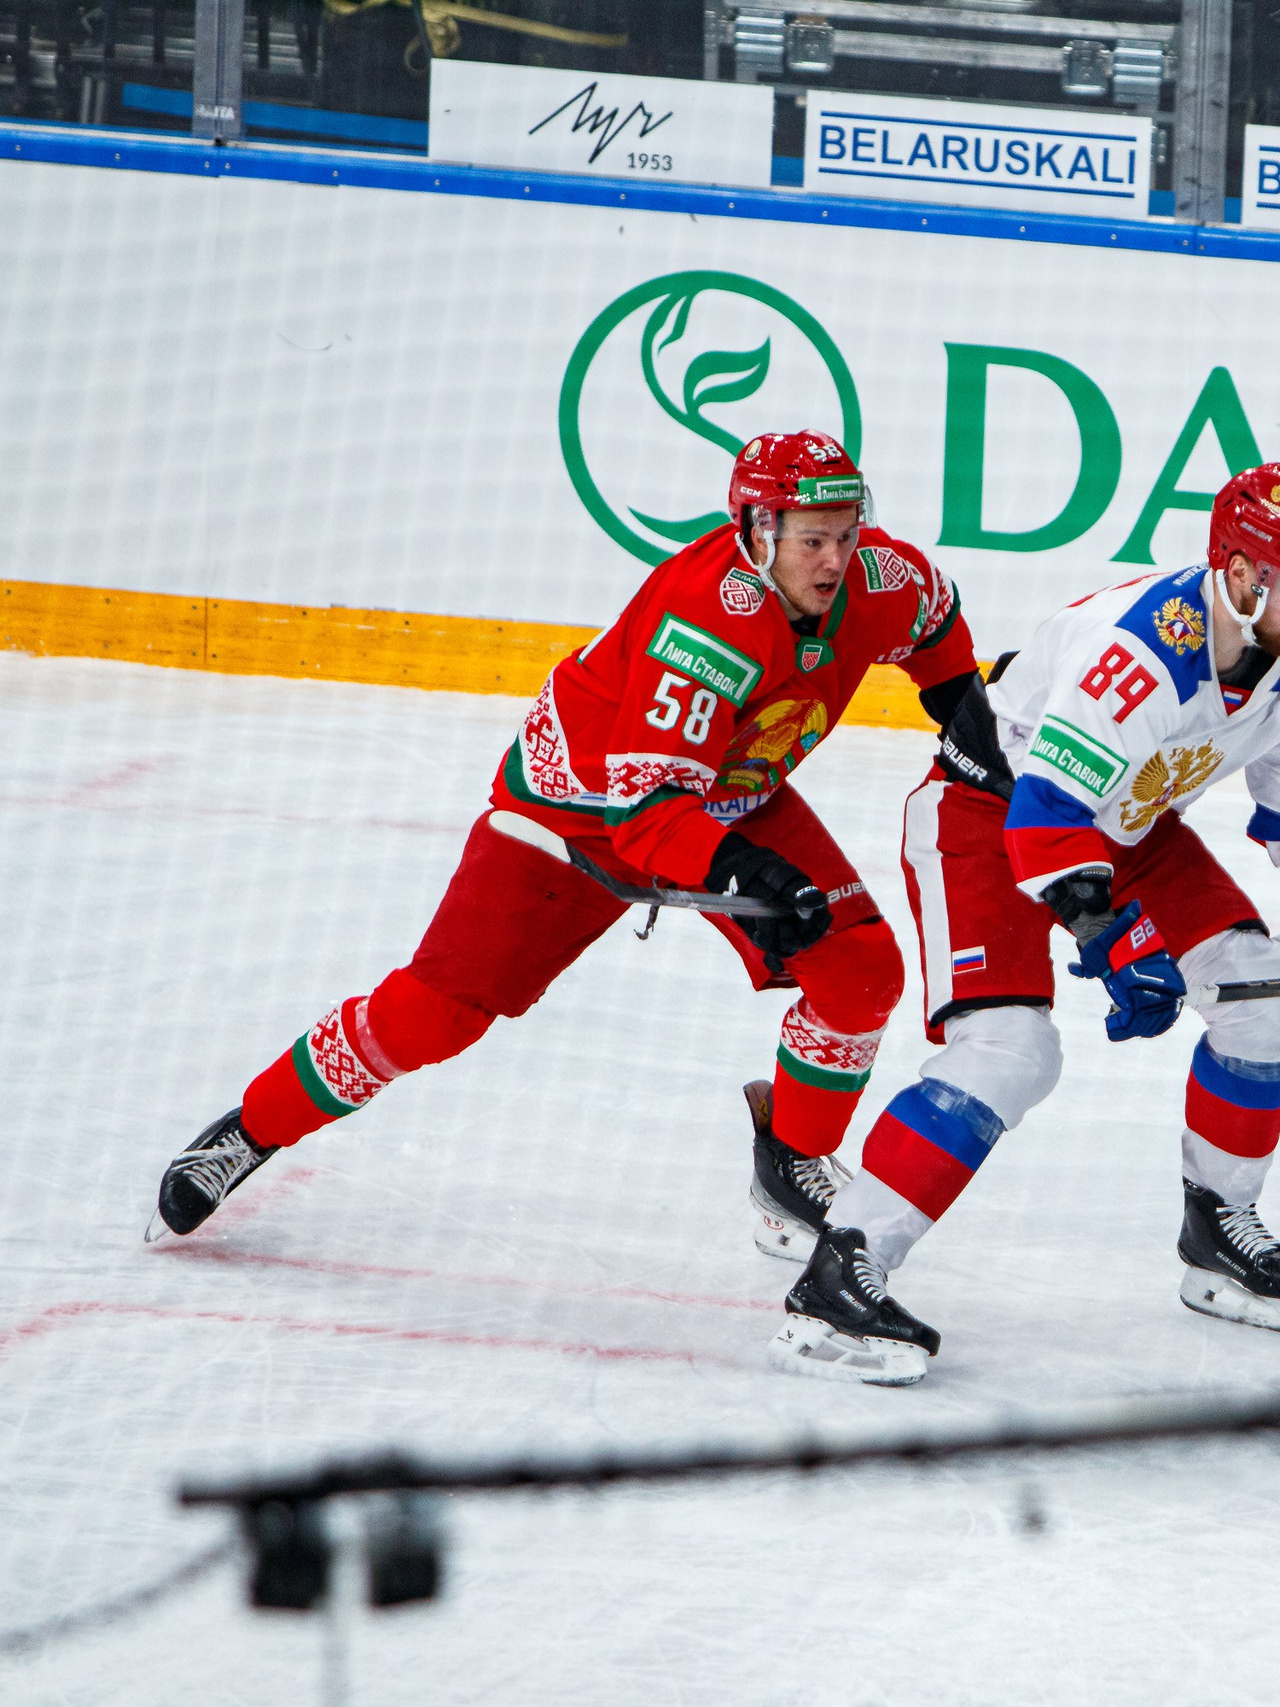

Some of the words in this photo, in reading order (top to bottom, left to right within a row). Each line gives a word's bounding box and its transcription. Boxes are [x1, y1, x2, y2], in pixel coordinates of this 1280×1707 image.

[627, 152, 673, 172] 1953
[818, 124, 1136, 185] BELARUSKALI
[806, 444, 842, 461] 58
[740, 486, 762, 498] CCM
[1079, 641, 1160, 724] 89
[645, 671, 718, 746] 58
[1216, 1251, 1247, 1277] BAUER
[839, 1289, 867, 1312] BAUER
